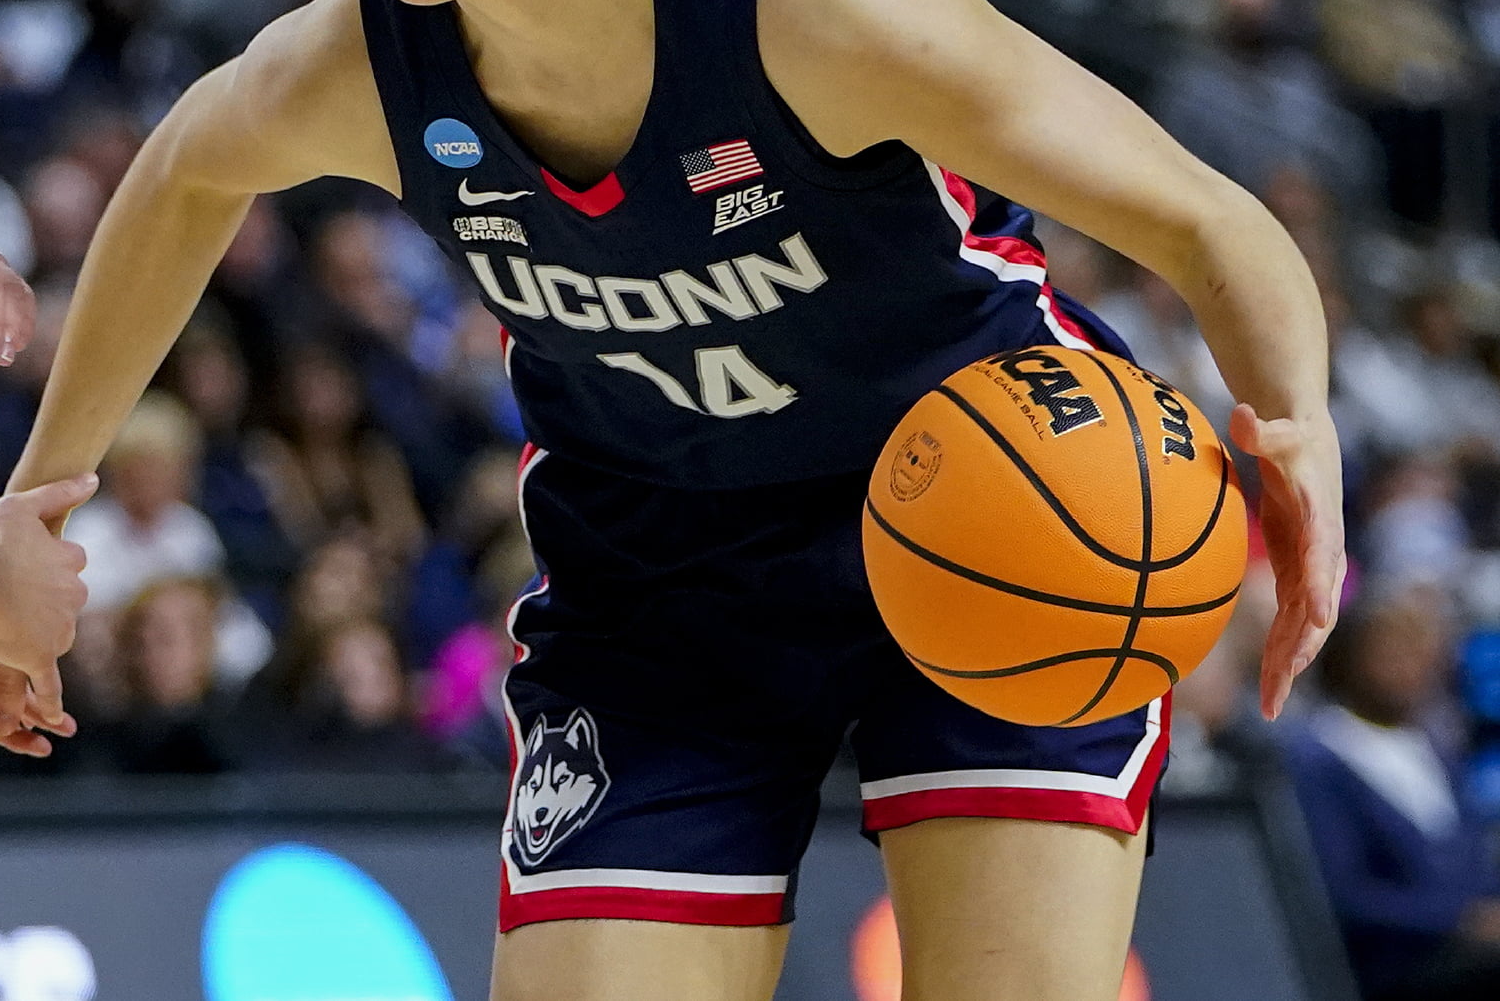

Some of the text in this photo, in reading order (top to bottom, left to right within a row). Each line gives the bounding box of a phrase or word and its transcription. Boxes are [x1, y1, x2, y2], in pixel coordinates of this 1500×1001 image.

[434, 142, 480, 156] NCAA
[715, 191, 784, 227] EAST
[716, 184, 764, 212] BIG
[465, 231, 828, 332] UCONN
[597, 345, 798, 418] 14
[993, 376, 1044, 441] GAME BALL
